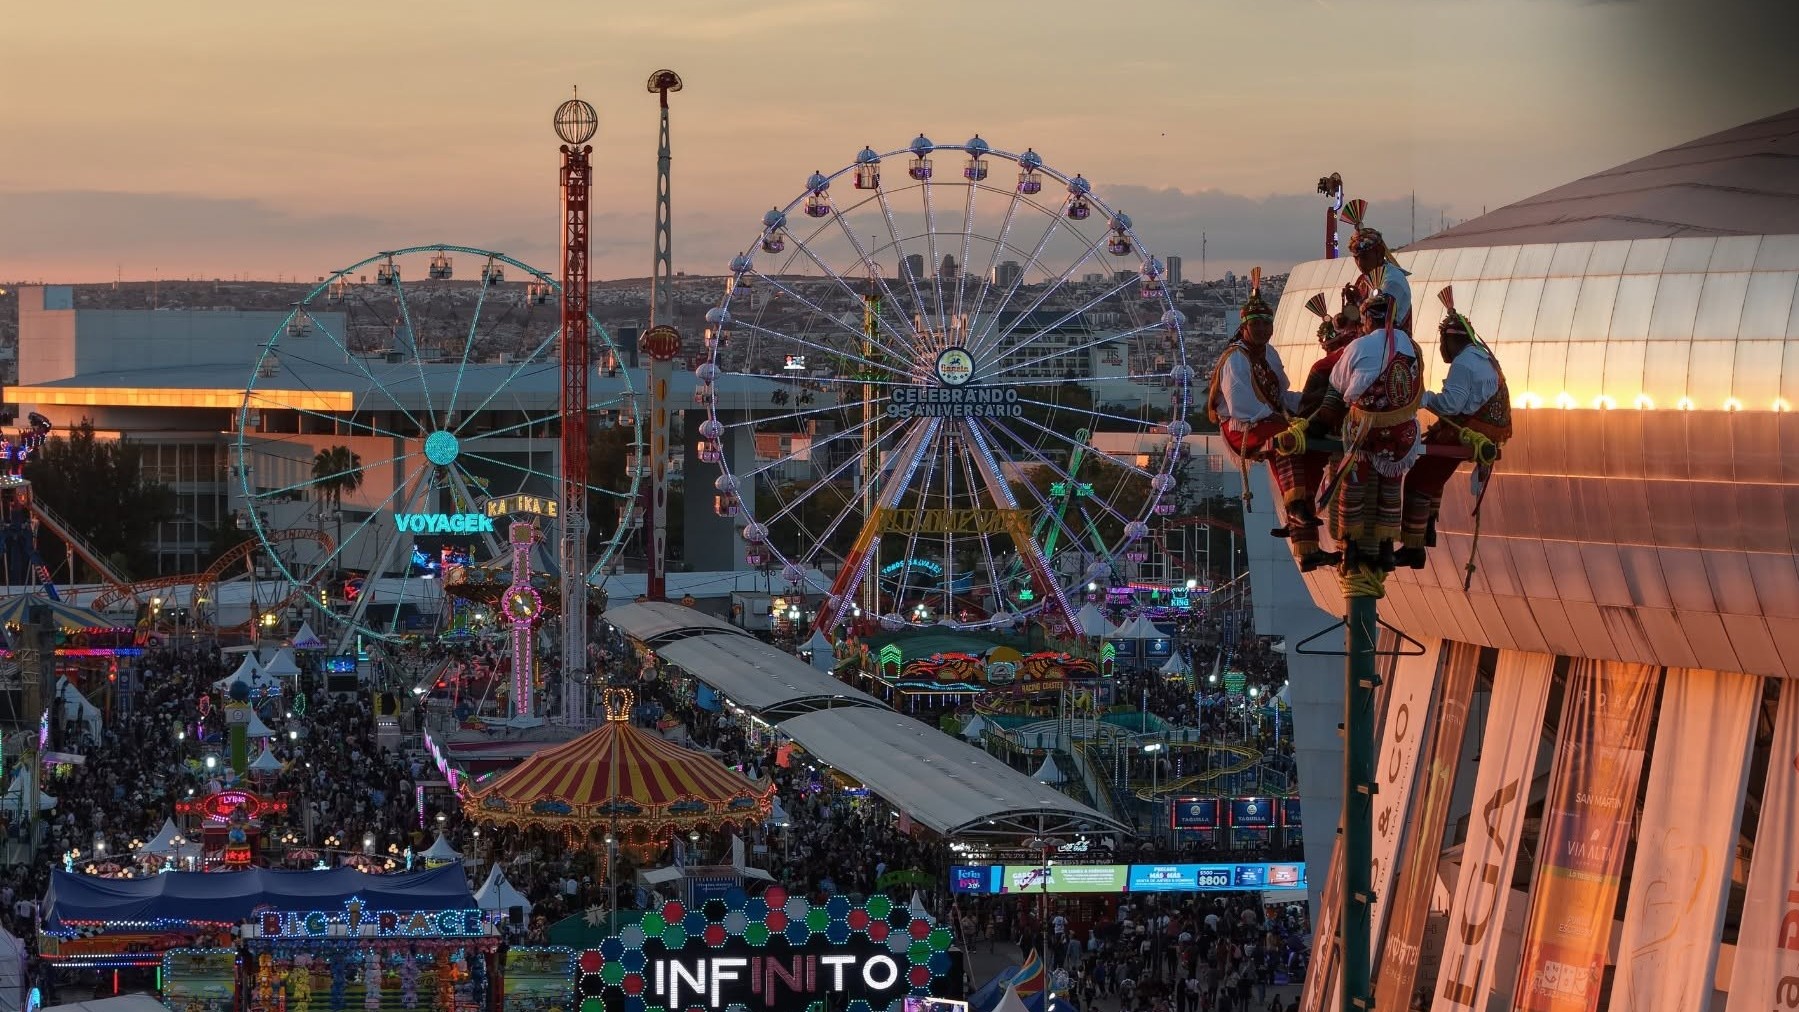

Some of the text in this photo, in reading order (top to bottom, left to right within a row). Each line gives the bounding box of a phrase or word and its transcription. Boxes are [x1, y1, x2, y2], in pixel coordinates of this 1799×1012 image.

[892, 388, 1018, 403] CELEBRANDO
[886, 404, 1022, 418] 95 ANIVERSARIO
[394, 513, 495, 533] VOYAGER
[1170, 598, 1189, 607] KING
[1021, 682, 1041, 692] RACING
[1575, 792, 1593, 804] SAN
[1567, 840, 1585, 857] VIA
[1199, 875, 1228, 886] $800
[260, 909, 485, 938] BIG RACE
[655, 954, 898, 1009] INFINITO
